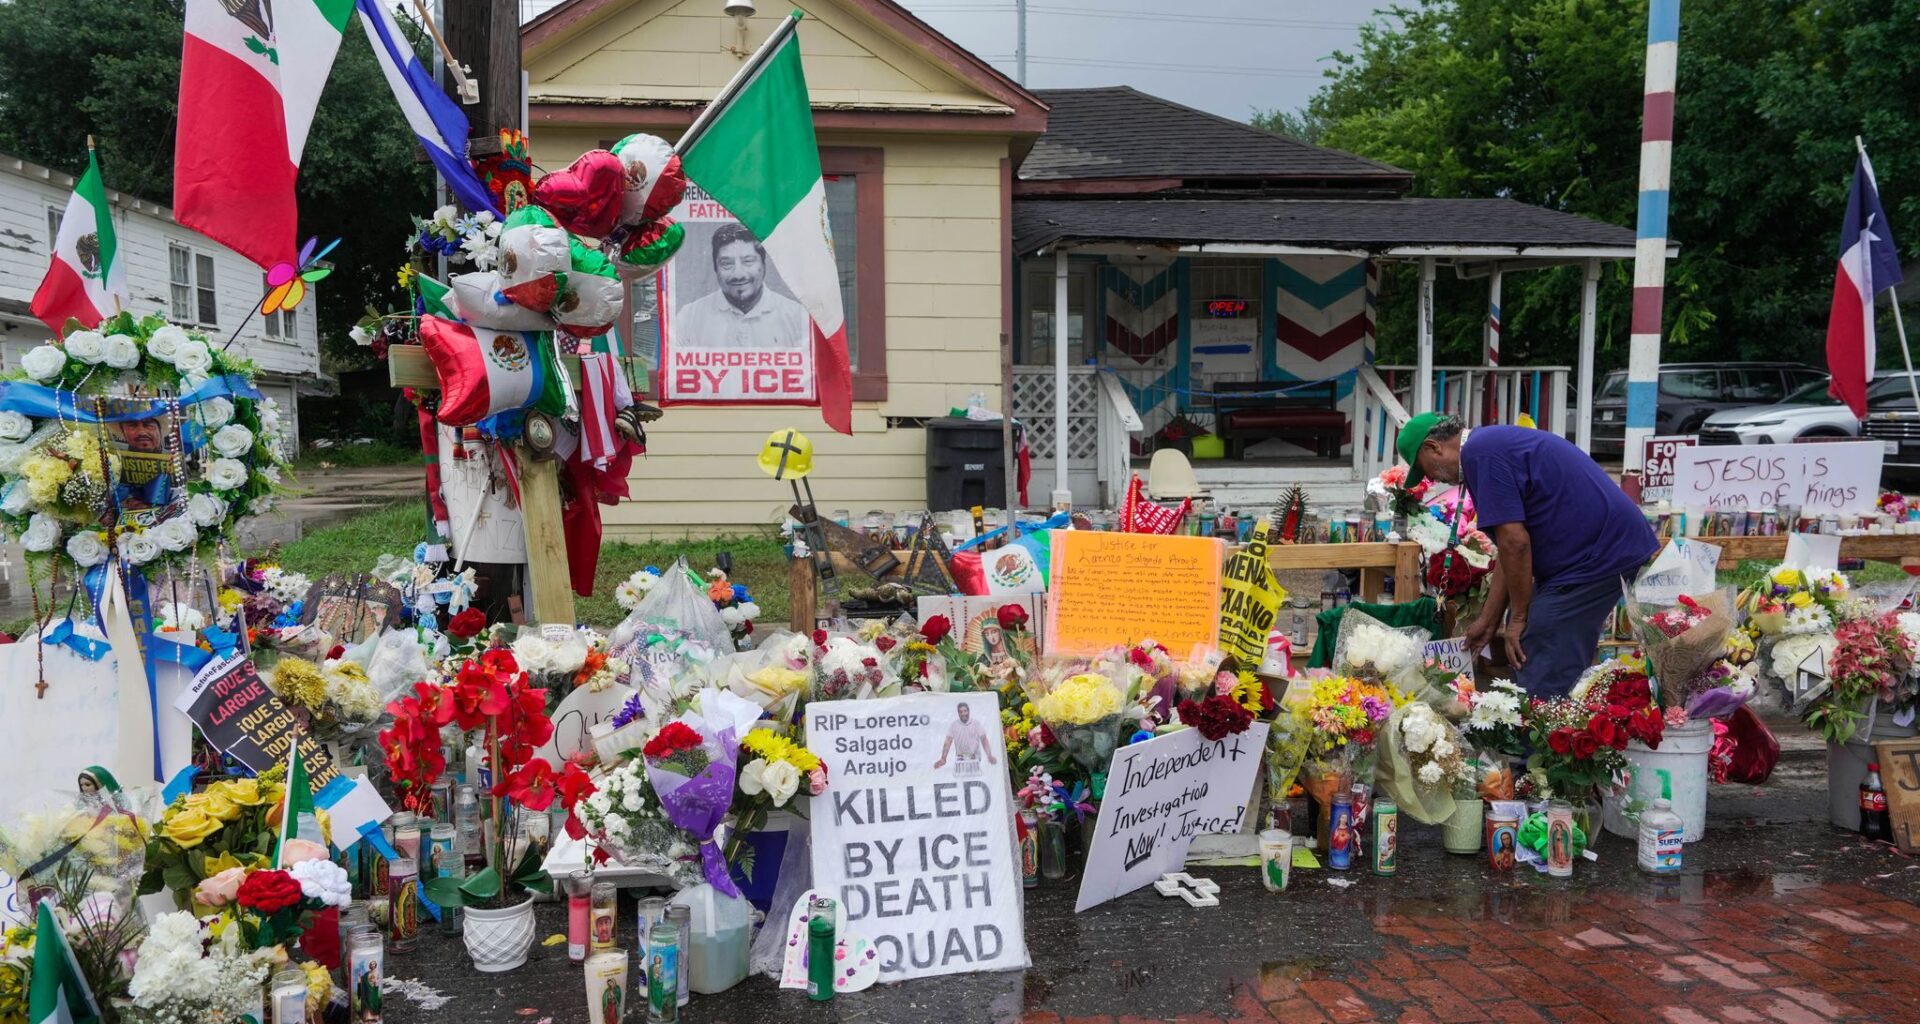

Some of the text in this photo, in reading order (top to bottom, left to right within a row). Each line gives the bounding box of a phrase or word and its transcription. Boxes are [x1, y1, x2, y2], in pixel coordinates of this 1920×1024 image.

[1209, 301, 1245, 312] OPEN
[675, 351, 804, 367] MURDERED
[676, 369, 805, 394] BY ICE
[122, 458, 158, 473] USTICE
[1646, 458, 1673, 476] SA
[1694, 456, 1786, 491] JESUS
[1650, 476, 1661, 487] BY
[209, 681, 266, 726] LARGUE
[814, 714, 931, 731] RIP Lorenzo
[835, 734, 913, 756] Salgado
[843, 757, 907, 777] Araujo
[1119, 738, 1246, 797] Independent
[832, 780, 992, 827] KILLED
[1109, 779, 1209, 838] Investigation
[844, 830, 992, 879] BY ICE
[840, 871, 992, 922] DEATH
[873, 923, 1004, 974] QUAD
